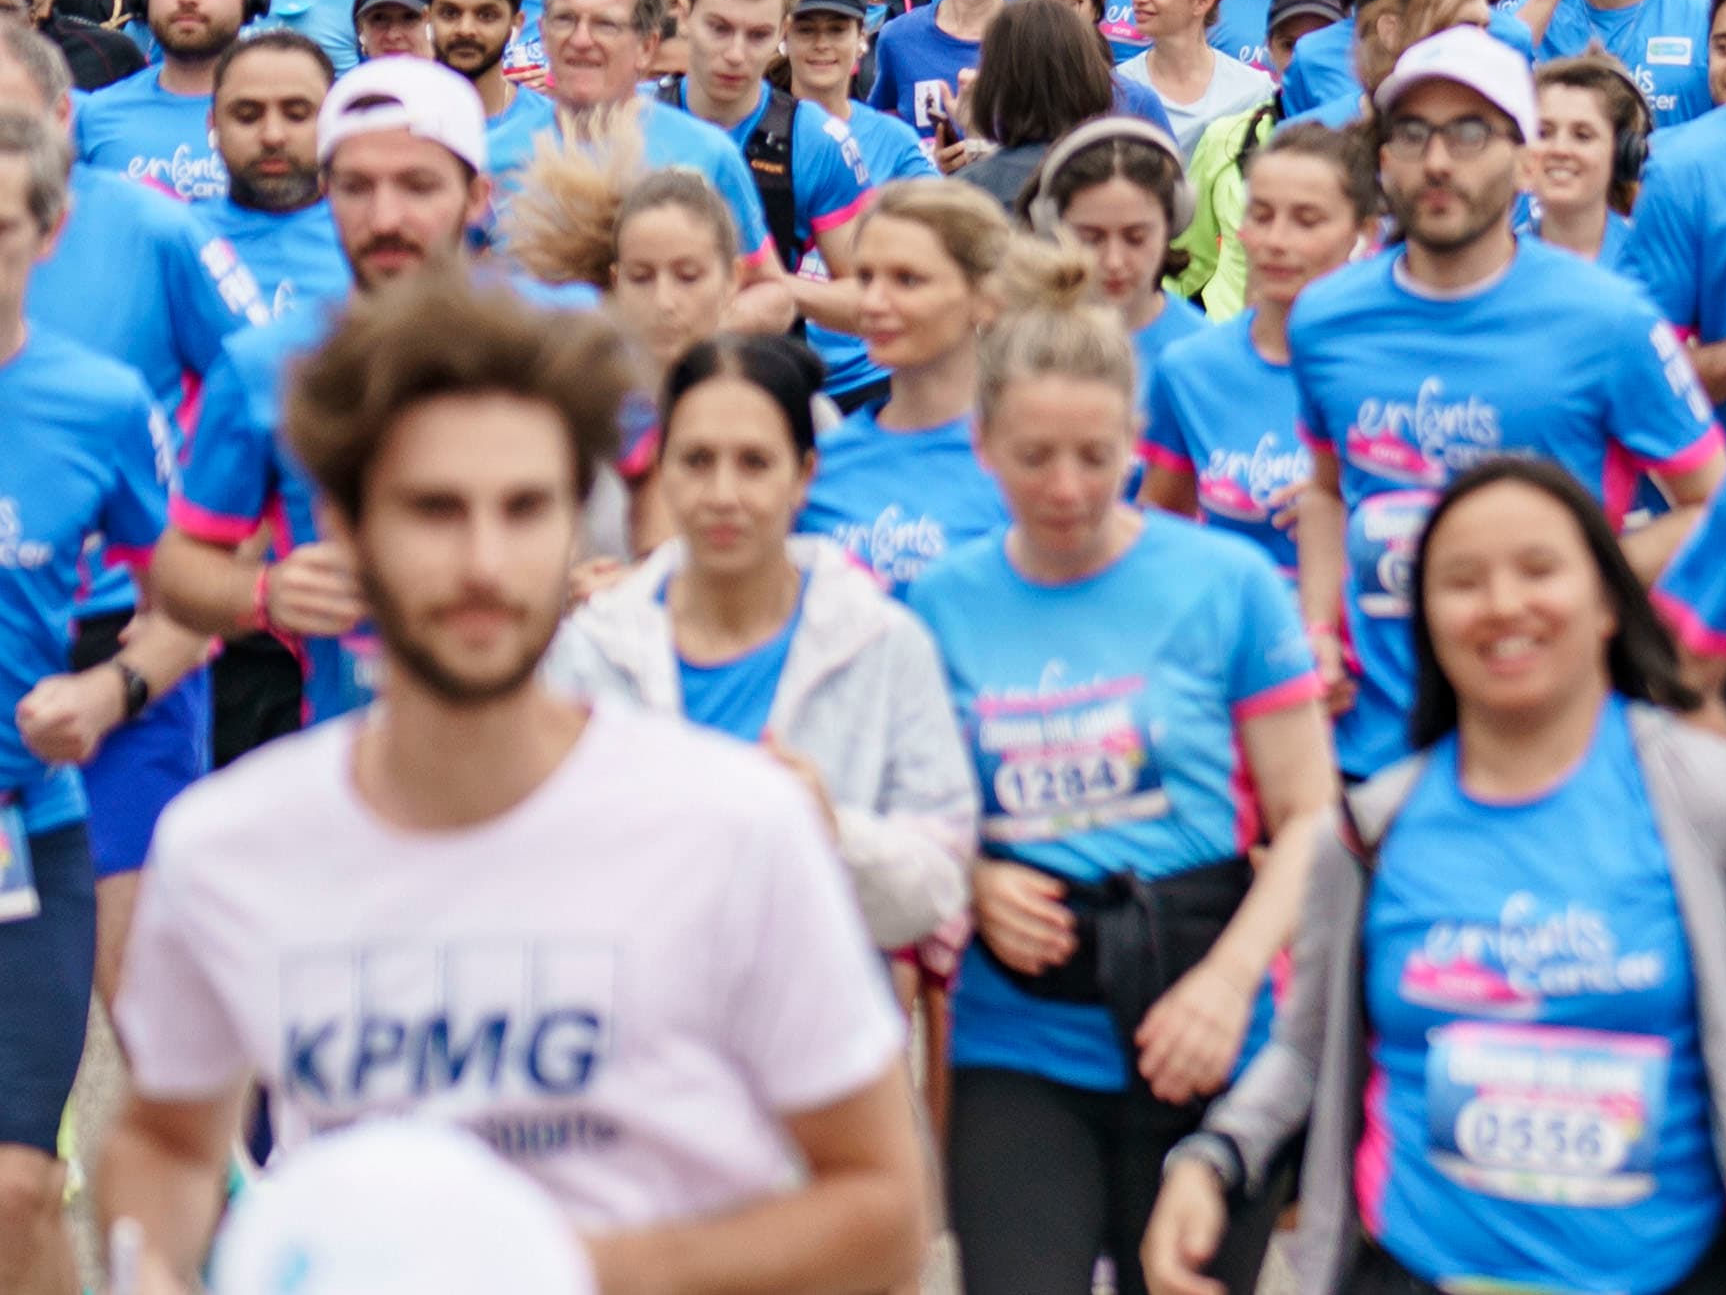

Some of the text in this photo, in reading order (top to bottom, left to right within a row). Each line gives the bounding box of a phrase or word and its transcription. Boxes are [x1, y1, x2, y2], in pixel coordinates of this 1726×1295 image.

[120, 142, 229, 183] enfant
[1356, 375, 1502, 447] enfants
[1009, 754, 1118, 807] 1284
[281, 1007, 605, 1101] KPMG
